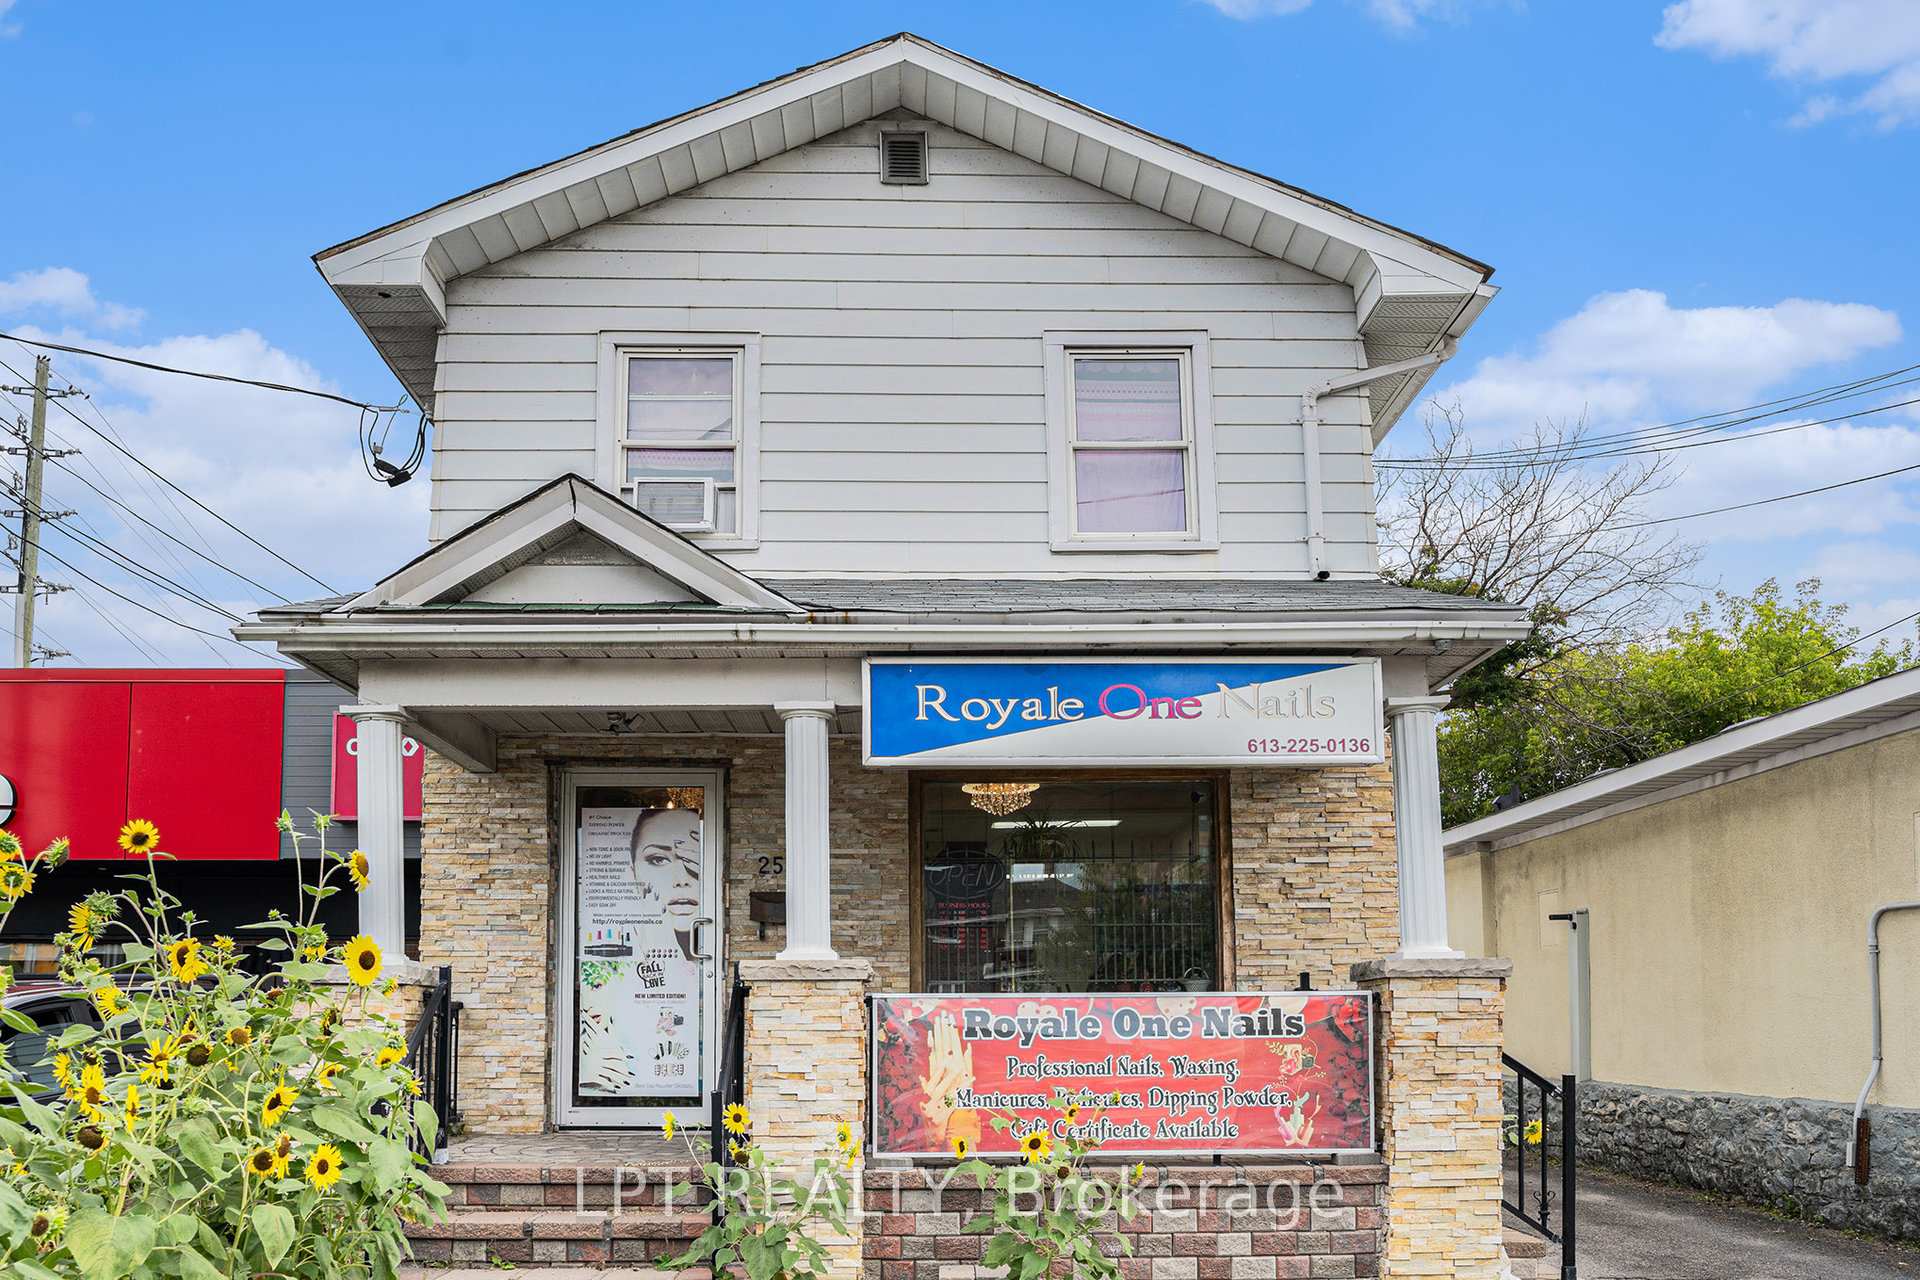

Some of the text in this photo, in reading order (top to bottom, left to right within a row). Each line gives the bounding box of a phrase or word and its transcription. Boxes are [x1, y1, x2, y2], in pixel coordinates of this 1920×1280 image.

[915, 682, 1336, 730] Royale One Nails
[1247, 737, 1370, 754] 613-225-0136
[930, 864, 998, 887] OPEN
[640, 961, 663, 975] FALL
[644, 977, 666, 989] LOVE
[963, 1006, 1306, 1048] Royale One Nails
[1007, 1055, 1113, 1081] Professional
[1148, 1087, 1218, 1115] Dipping
[1053, 1116, 1150, 1142] Certificate
[1156, 1118, 1239, 1140] Available
